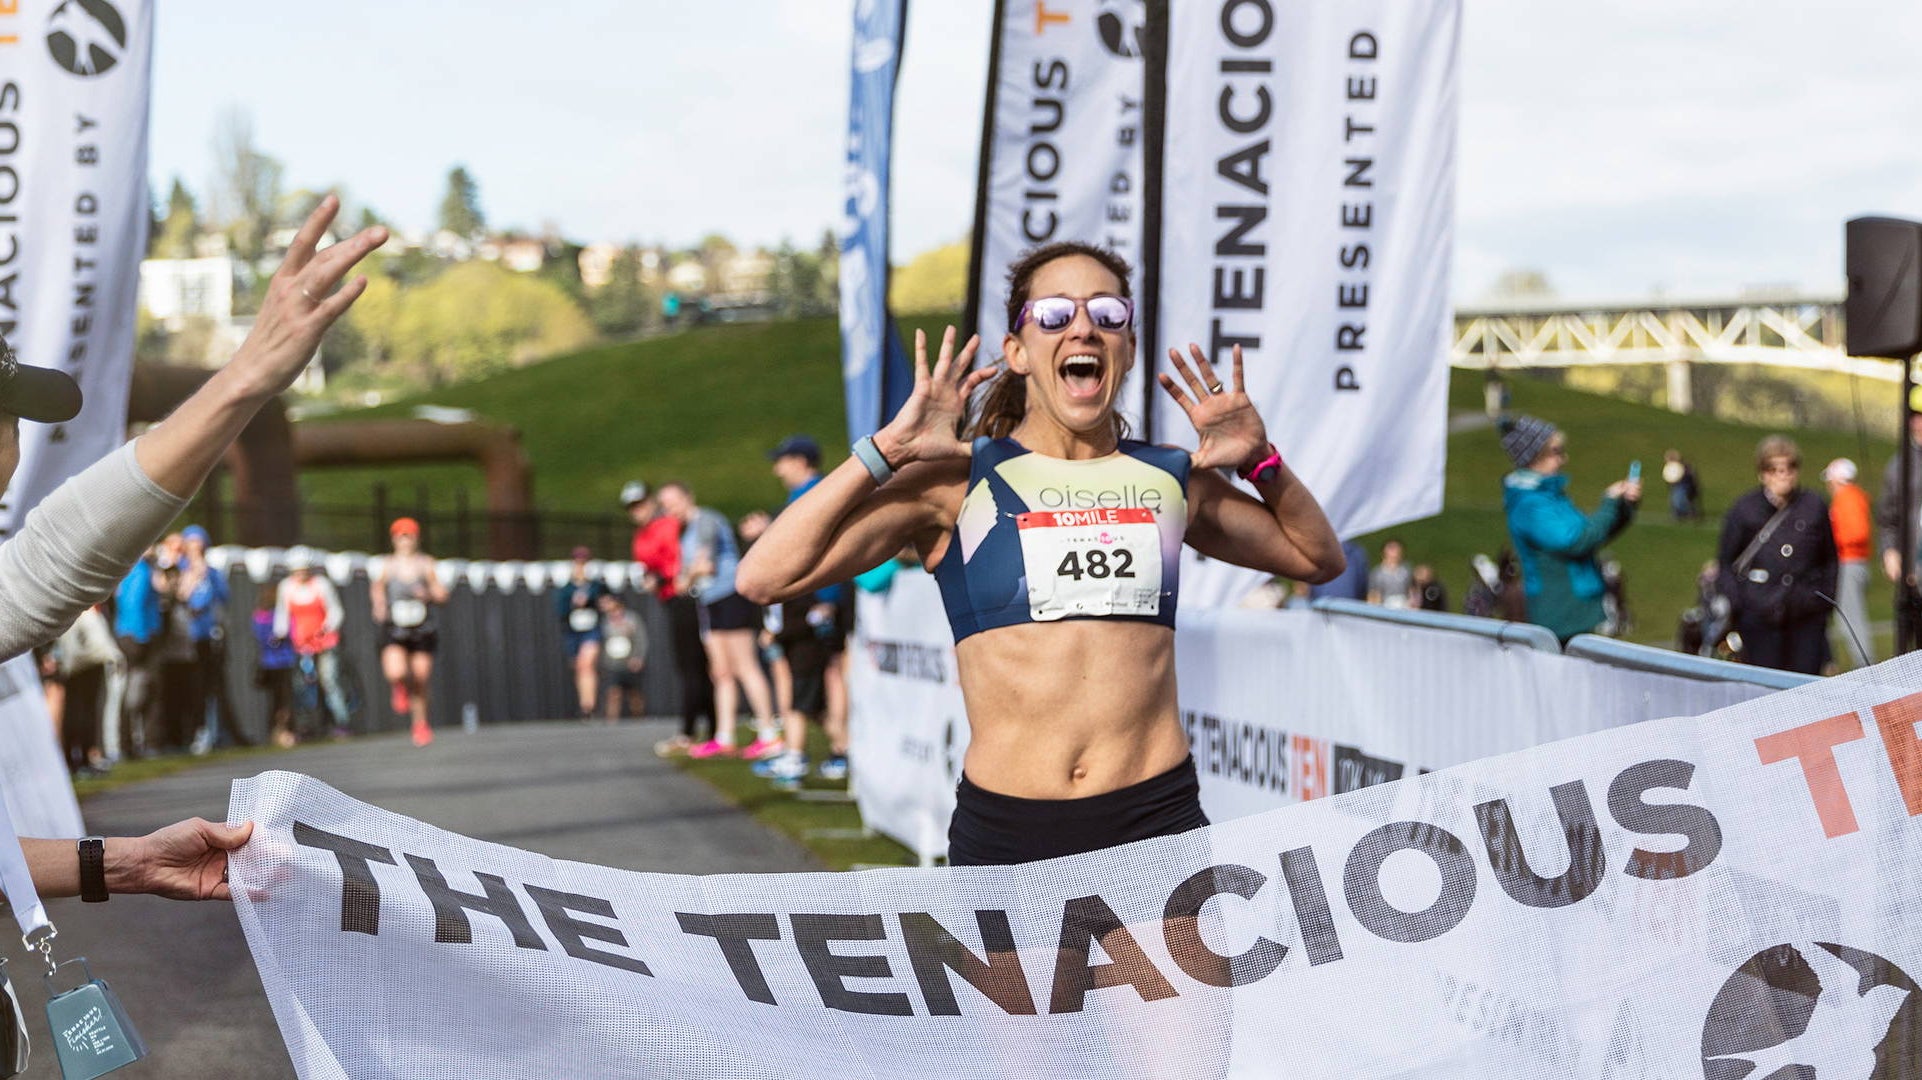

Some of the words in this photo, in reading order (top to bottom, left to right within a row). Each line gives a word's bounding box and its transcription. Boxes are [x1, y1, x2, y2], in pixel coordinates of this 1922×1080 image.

[75, 113, 97, 166] BY
[1023, 59, 1069, 242] CIOUS
[1210, 0, 1274, 364] TENACIO
[1335, 31, 1378, 391] PRESENTED
[1040, 485, 1162, 514] oiselle
[1057, 549, 1136, 581] 482
[1203, 715, 1288, 793] TENACIOUS
[1292, 734, 1328, 801] TEN
[293, 820, 655, 978] THE
[674, 758, 1722, 1016] TENACIOUS
